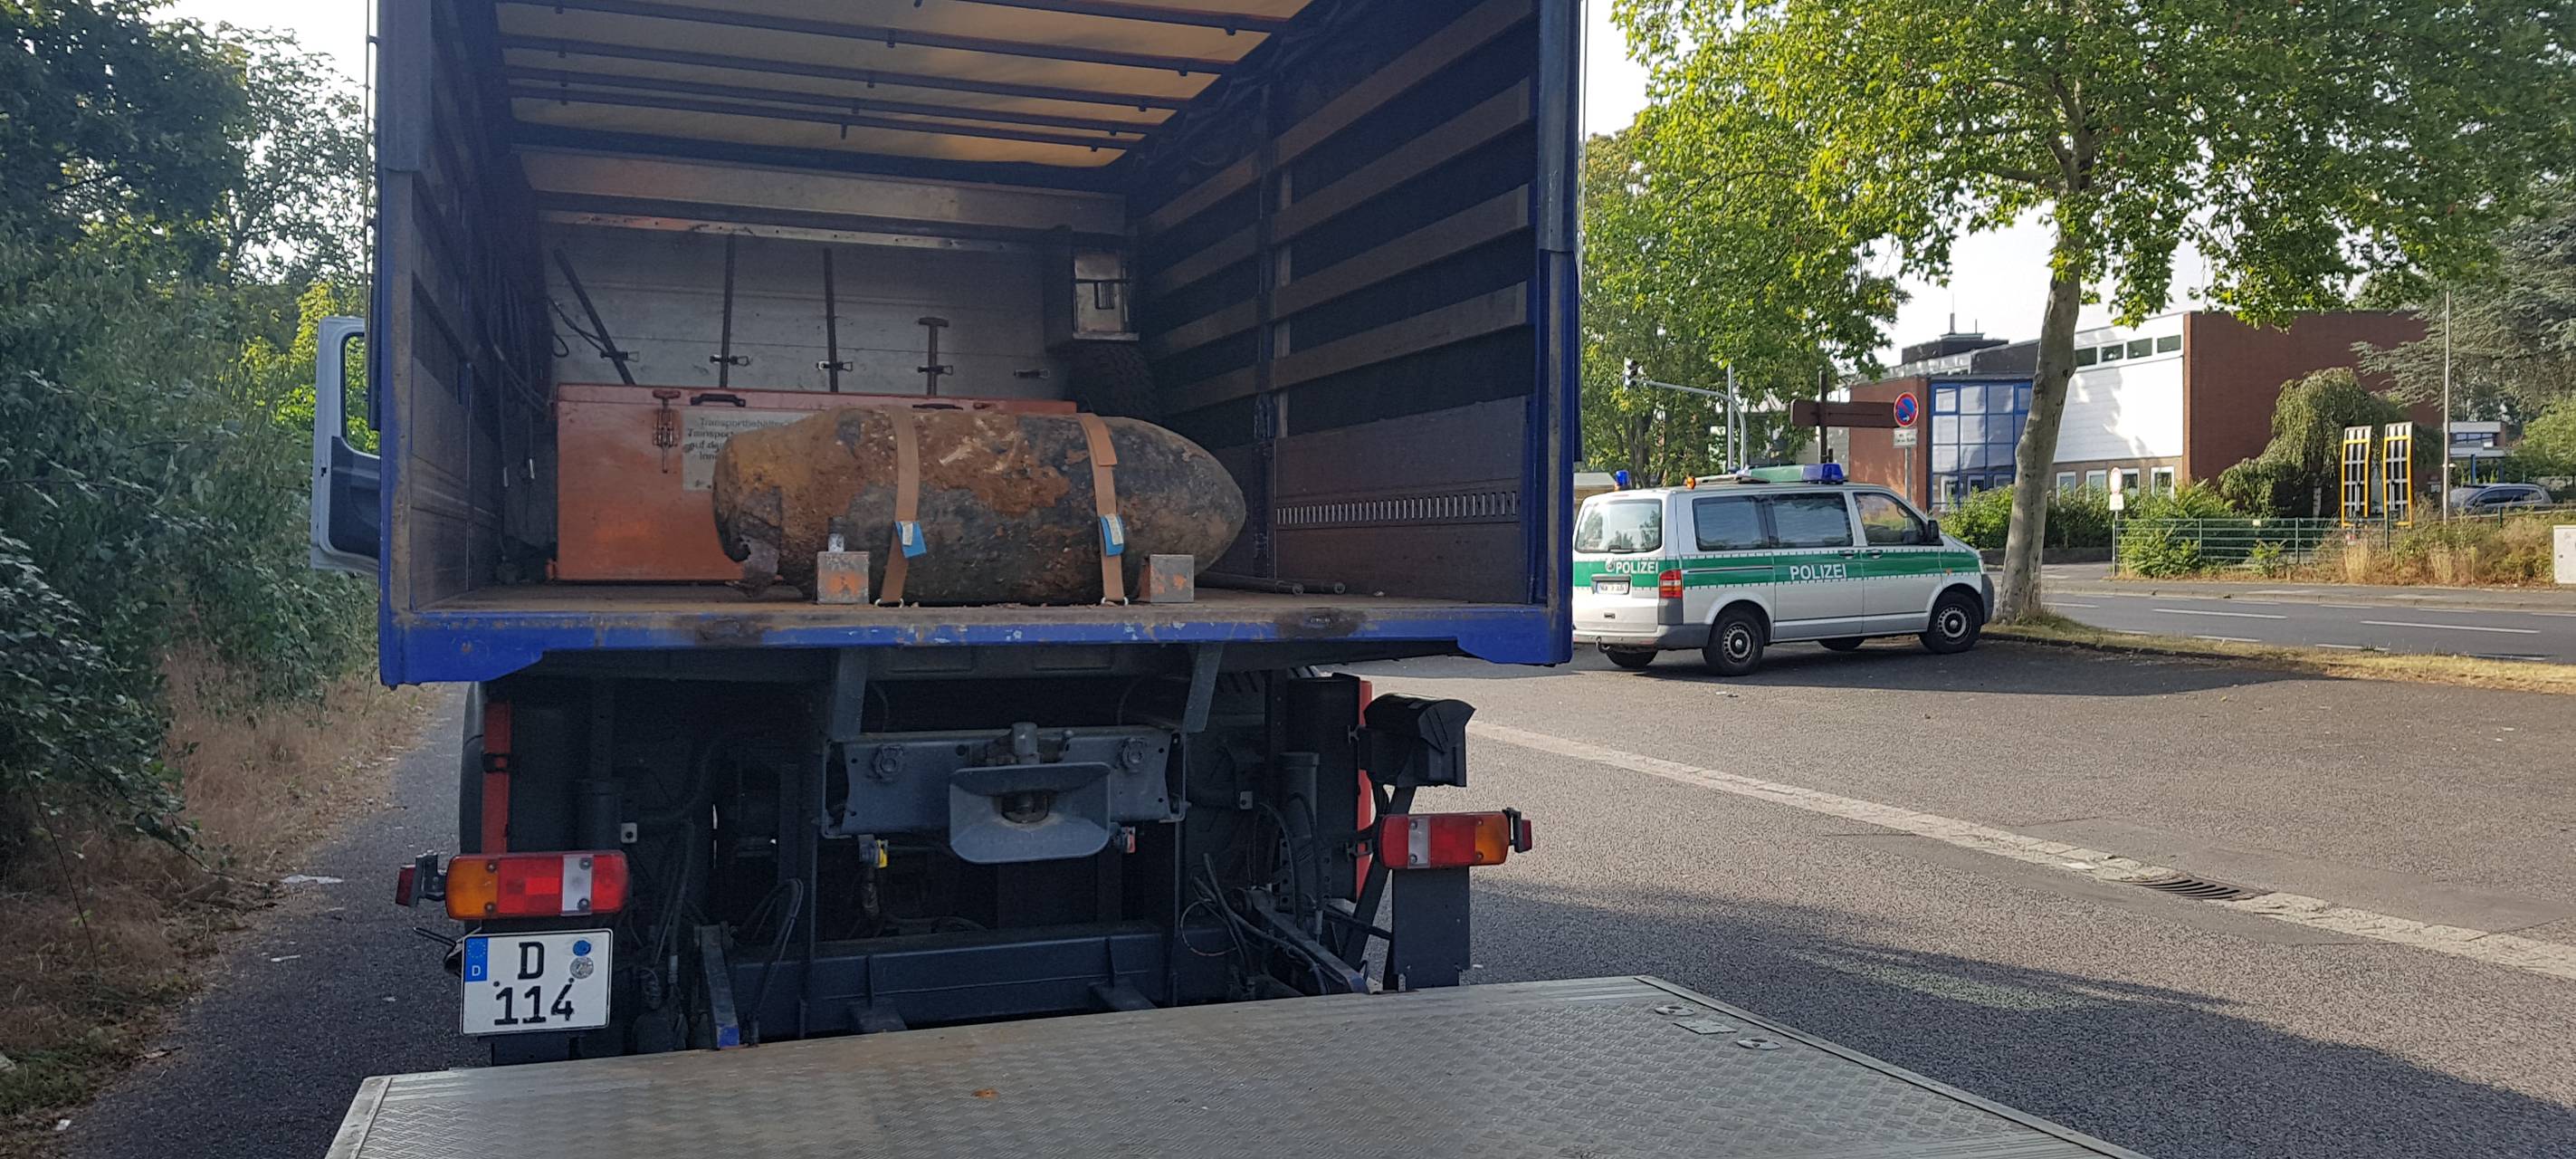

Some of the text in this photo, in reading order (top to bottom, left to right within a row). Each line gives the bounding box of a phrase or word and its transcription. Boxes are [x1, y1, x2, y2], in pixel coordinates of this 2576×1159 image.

[1616, 561, 1659, 574] POLIZEI
[1789, 563, 1847, 580] POLIZEI
[517, 941, 545, 981] D
[472, 964, 482, 977] D
[493, 983, 576, 1026] 114
